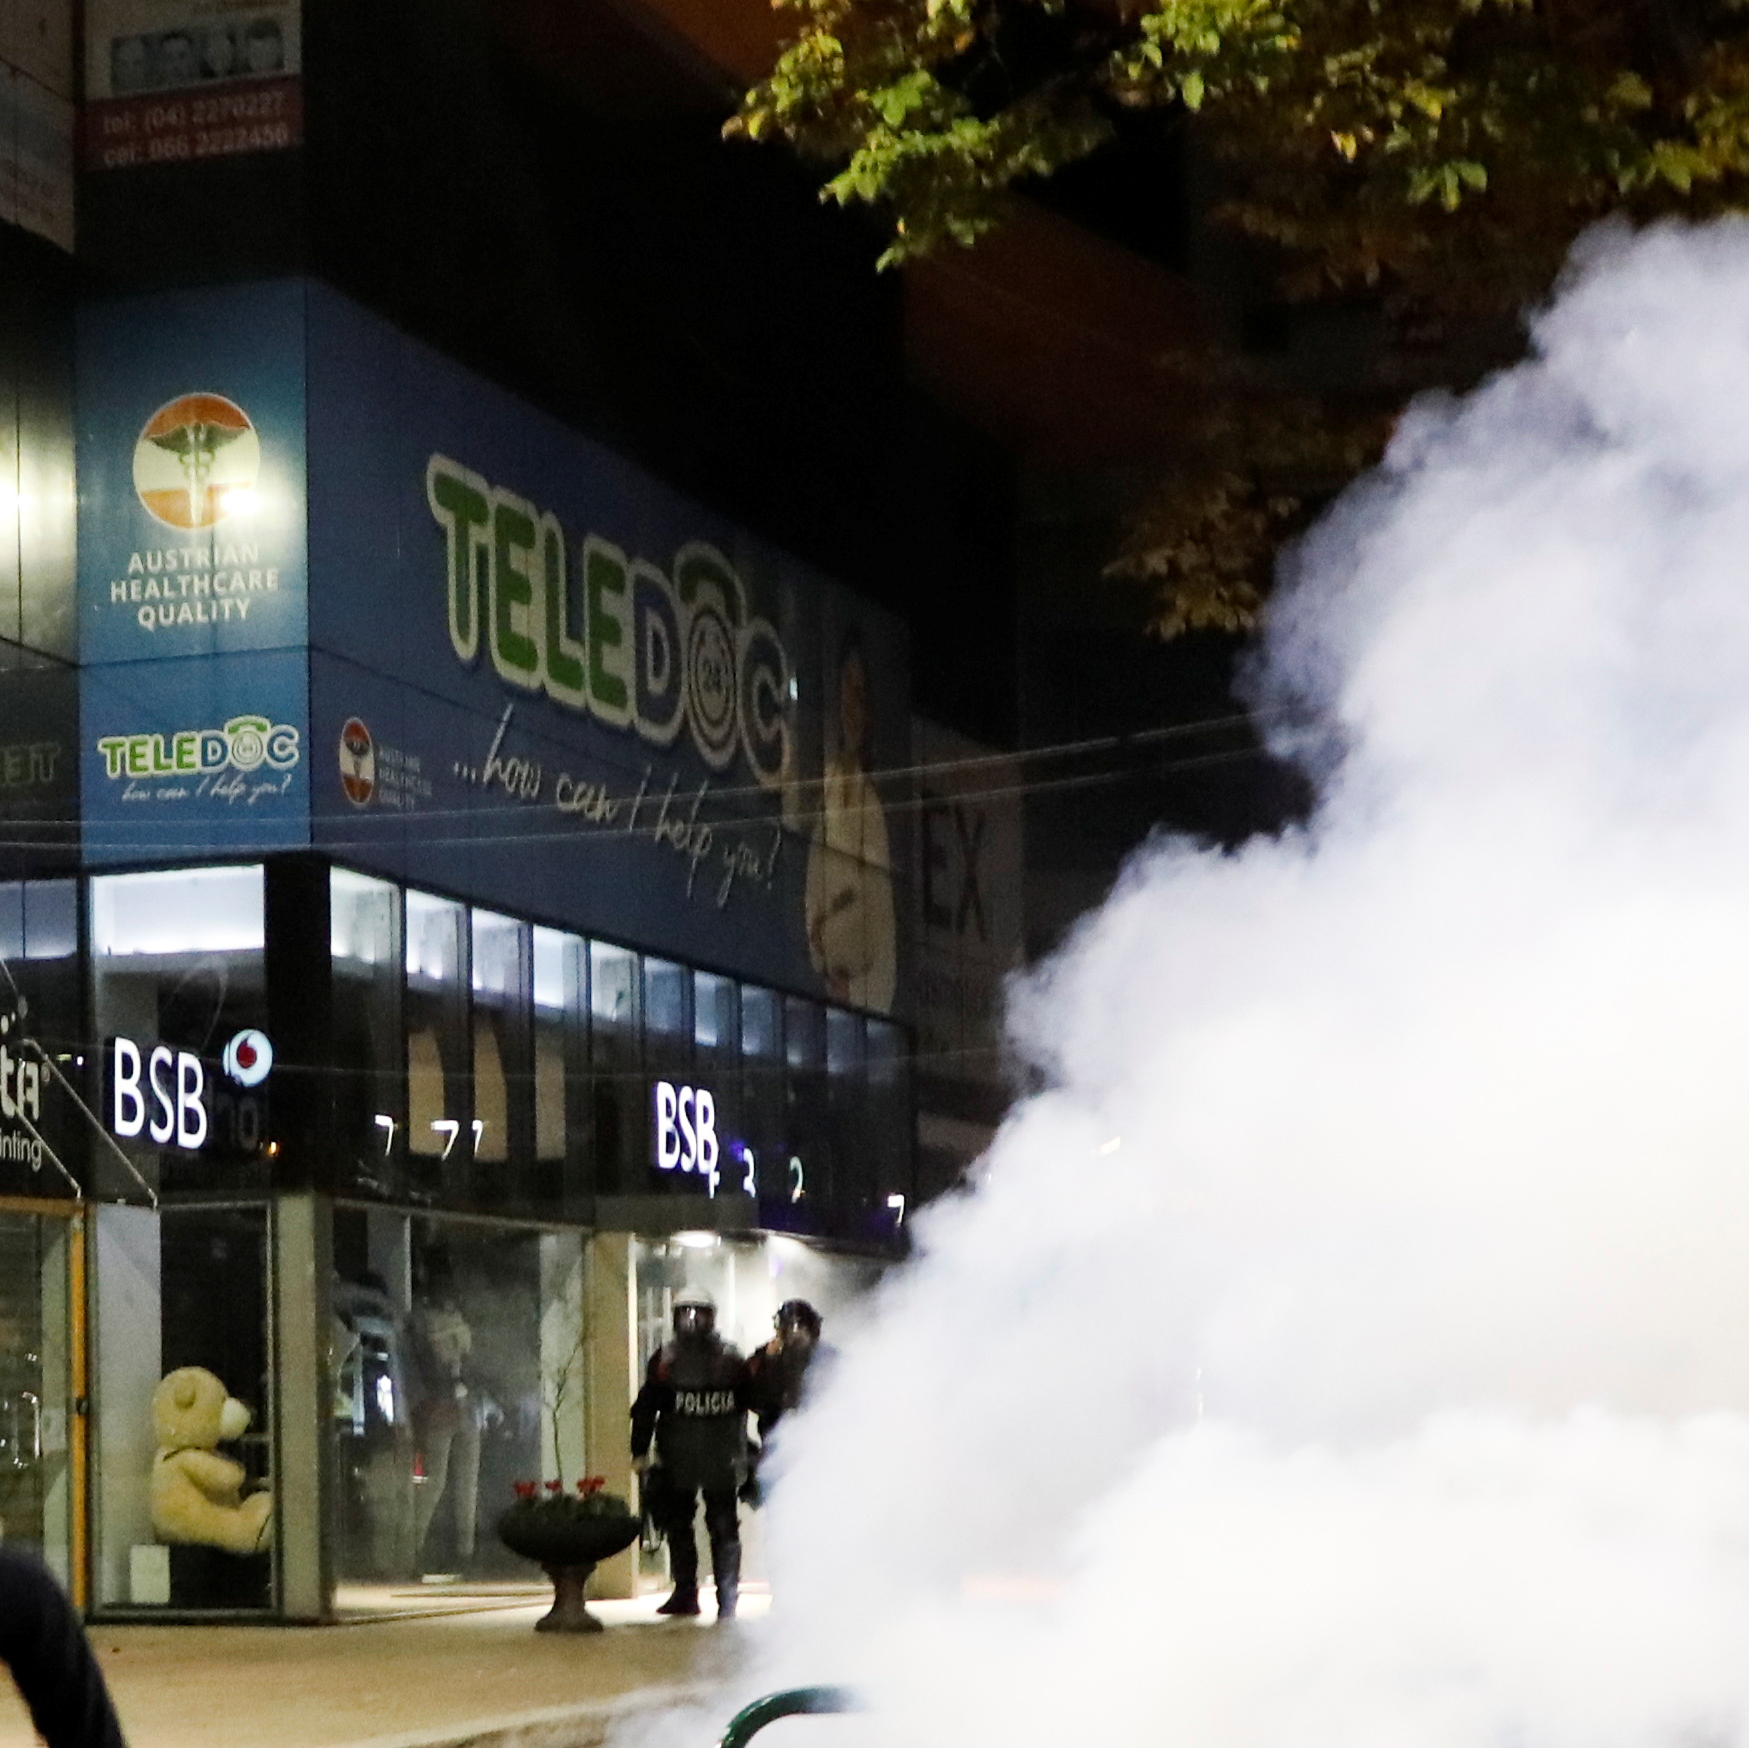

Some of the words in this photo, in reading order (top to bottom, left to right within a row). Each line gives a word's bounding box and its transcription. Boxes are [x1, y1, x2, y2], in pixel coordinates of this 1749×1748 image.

[128, 543, 259, 575] AUSTRIAN
[110, 567, 279, 603] HEALTHCARE
[137, 597, 251, 633] QUALITY
[427, 453, 790, 795] TELEDOC
[97, 714, 300, 780] TELEDOC
[113, 1036, 209, 1150] BSB
[656, 1081, 720, 1175] BSB
[674, 1390, 736, 1416] POLICIA
